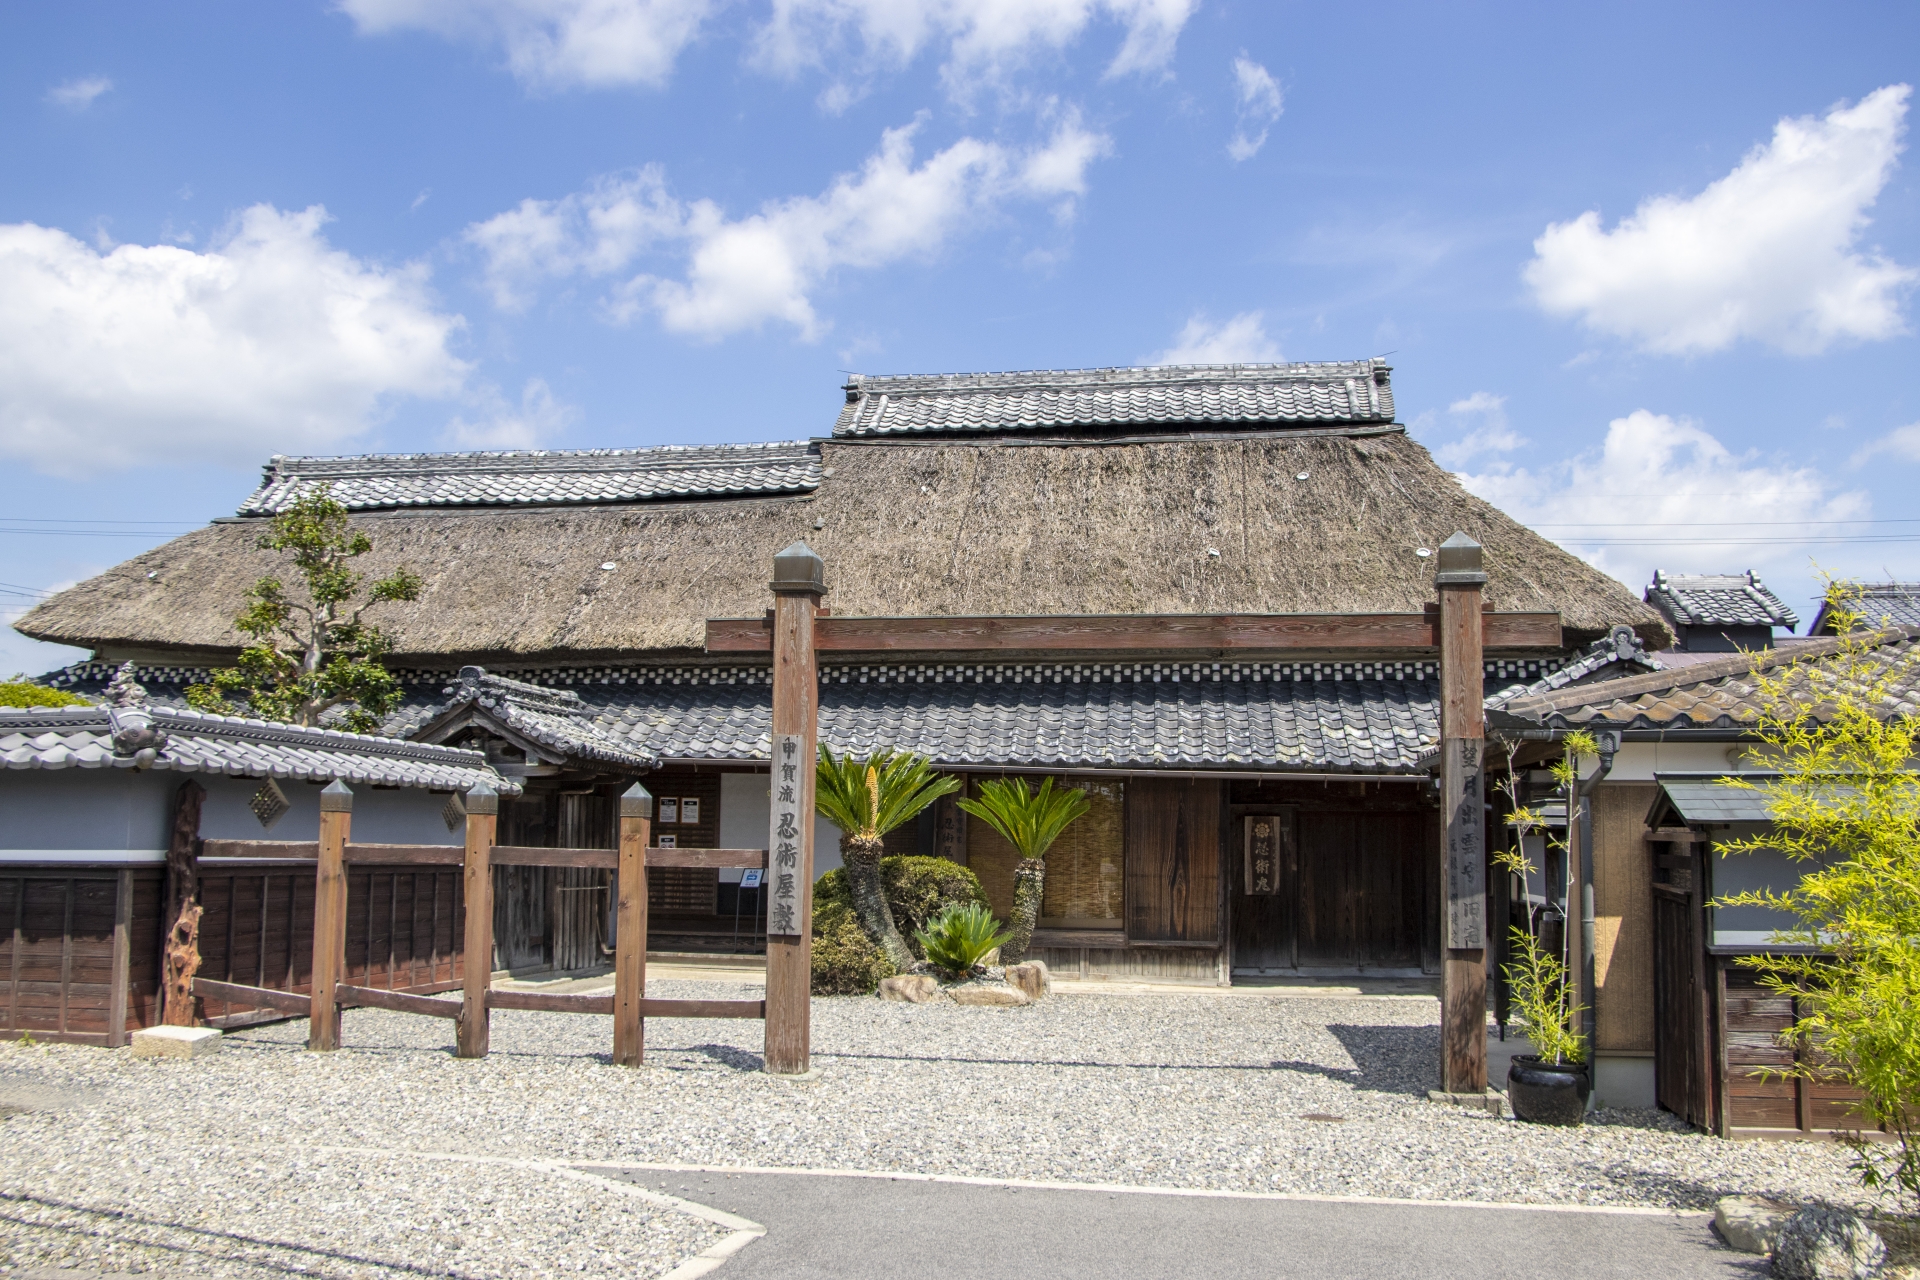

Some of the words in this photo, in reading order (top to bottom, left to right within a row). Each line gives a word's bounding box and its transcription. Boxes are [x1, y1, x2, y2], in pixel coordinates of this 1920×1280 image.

[773, 739, 799, 932] 甲賀流忍術屋敷
[1460, 745, 1481, 944] 望月出雲守旧宅
